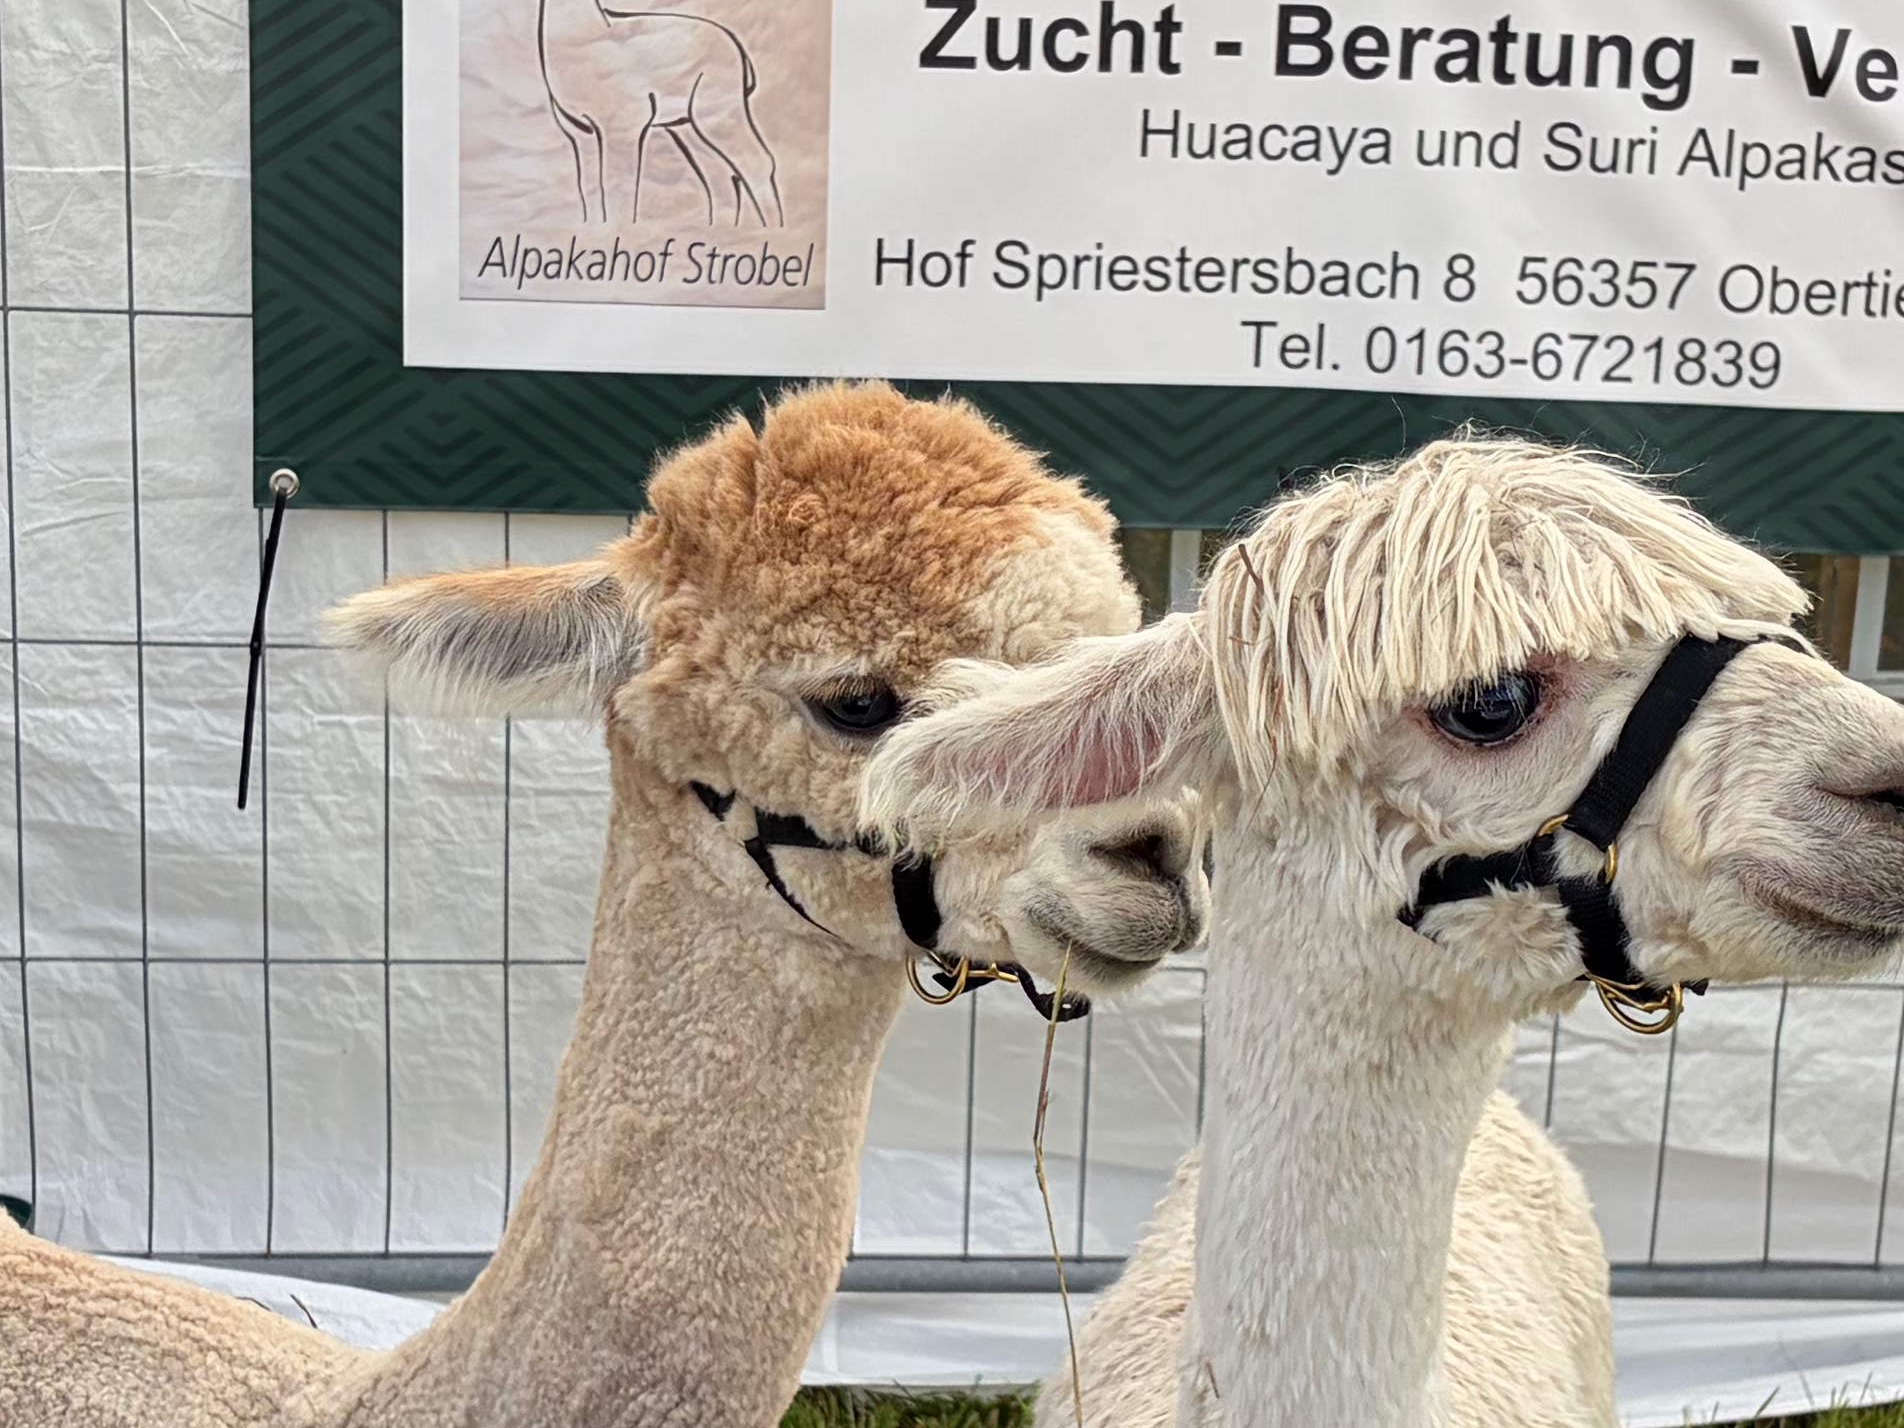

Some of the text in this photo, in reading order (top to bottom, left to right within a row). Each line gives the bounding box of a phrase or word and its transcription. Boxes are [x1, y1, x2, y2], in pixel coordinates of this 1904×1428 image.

[1214, 40, 1243, 57] -
[1274, 3, 1695, 113] Beratung
[1730, 58, 1760, 76] -
[1139, 108, 1392, 177] Huacaya
[1416, 119, 1522, 171] und
[1543, 121, 1658, 177] Suri
[477, 233, 815, 291] Alpakahof Strobel
[874, 237, 978, 288] Hof
[992, 239, 1420, 304] Spriestersbach
[1443, 252, 1477, 303] 8
[1515, 255, 1698, 311] 56357
[1240, 320, 1782, 390] Tel. 0163-6721839
